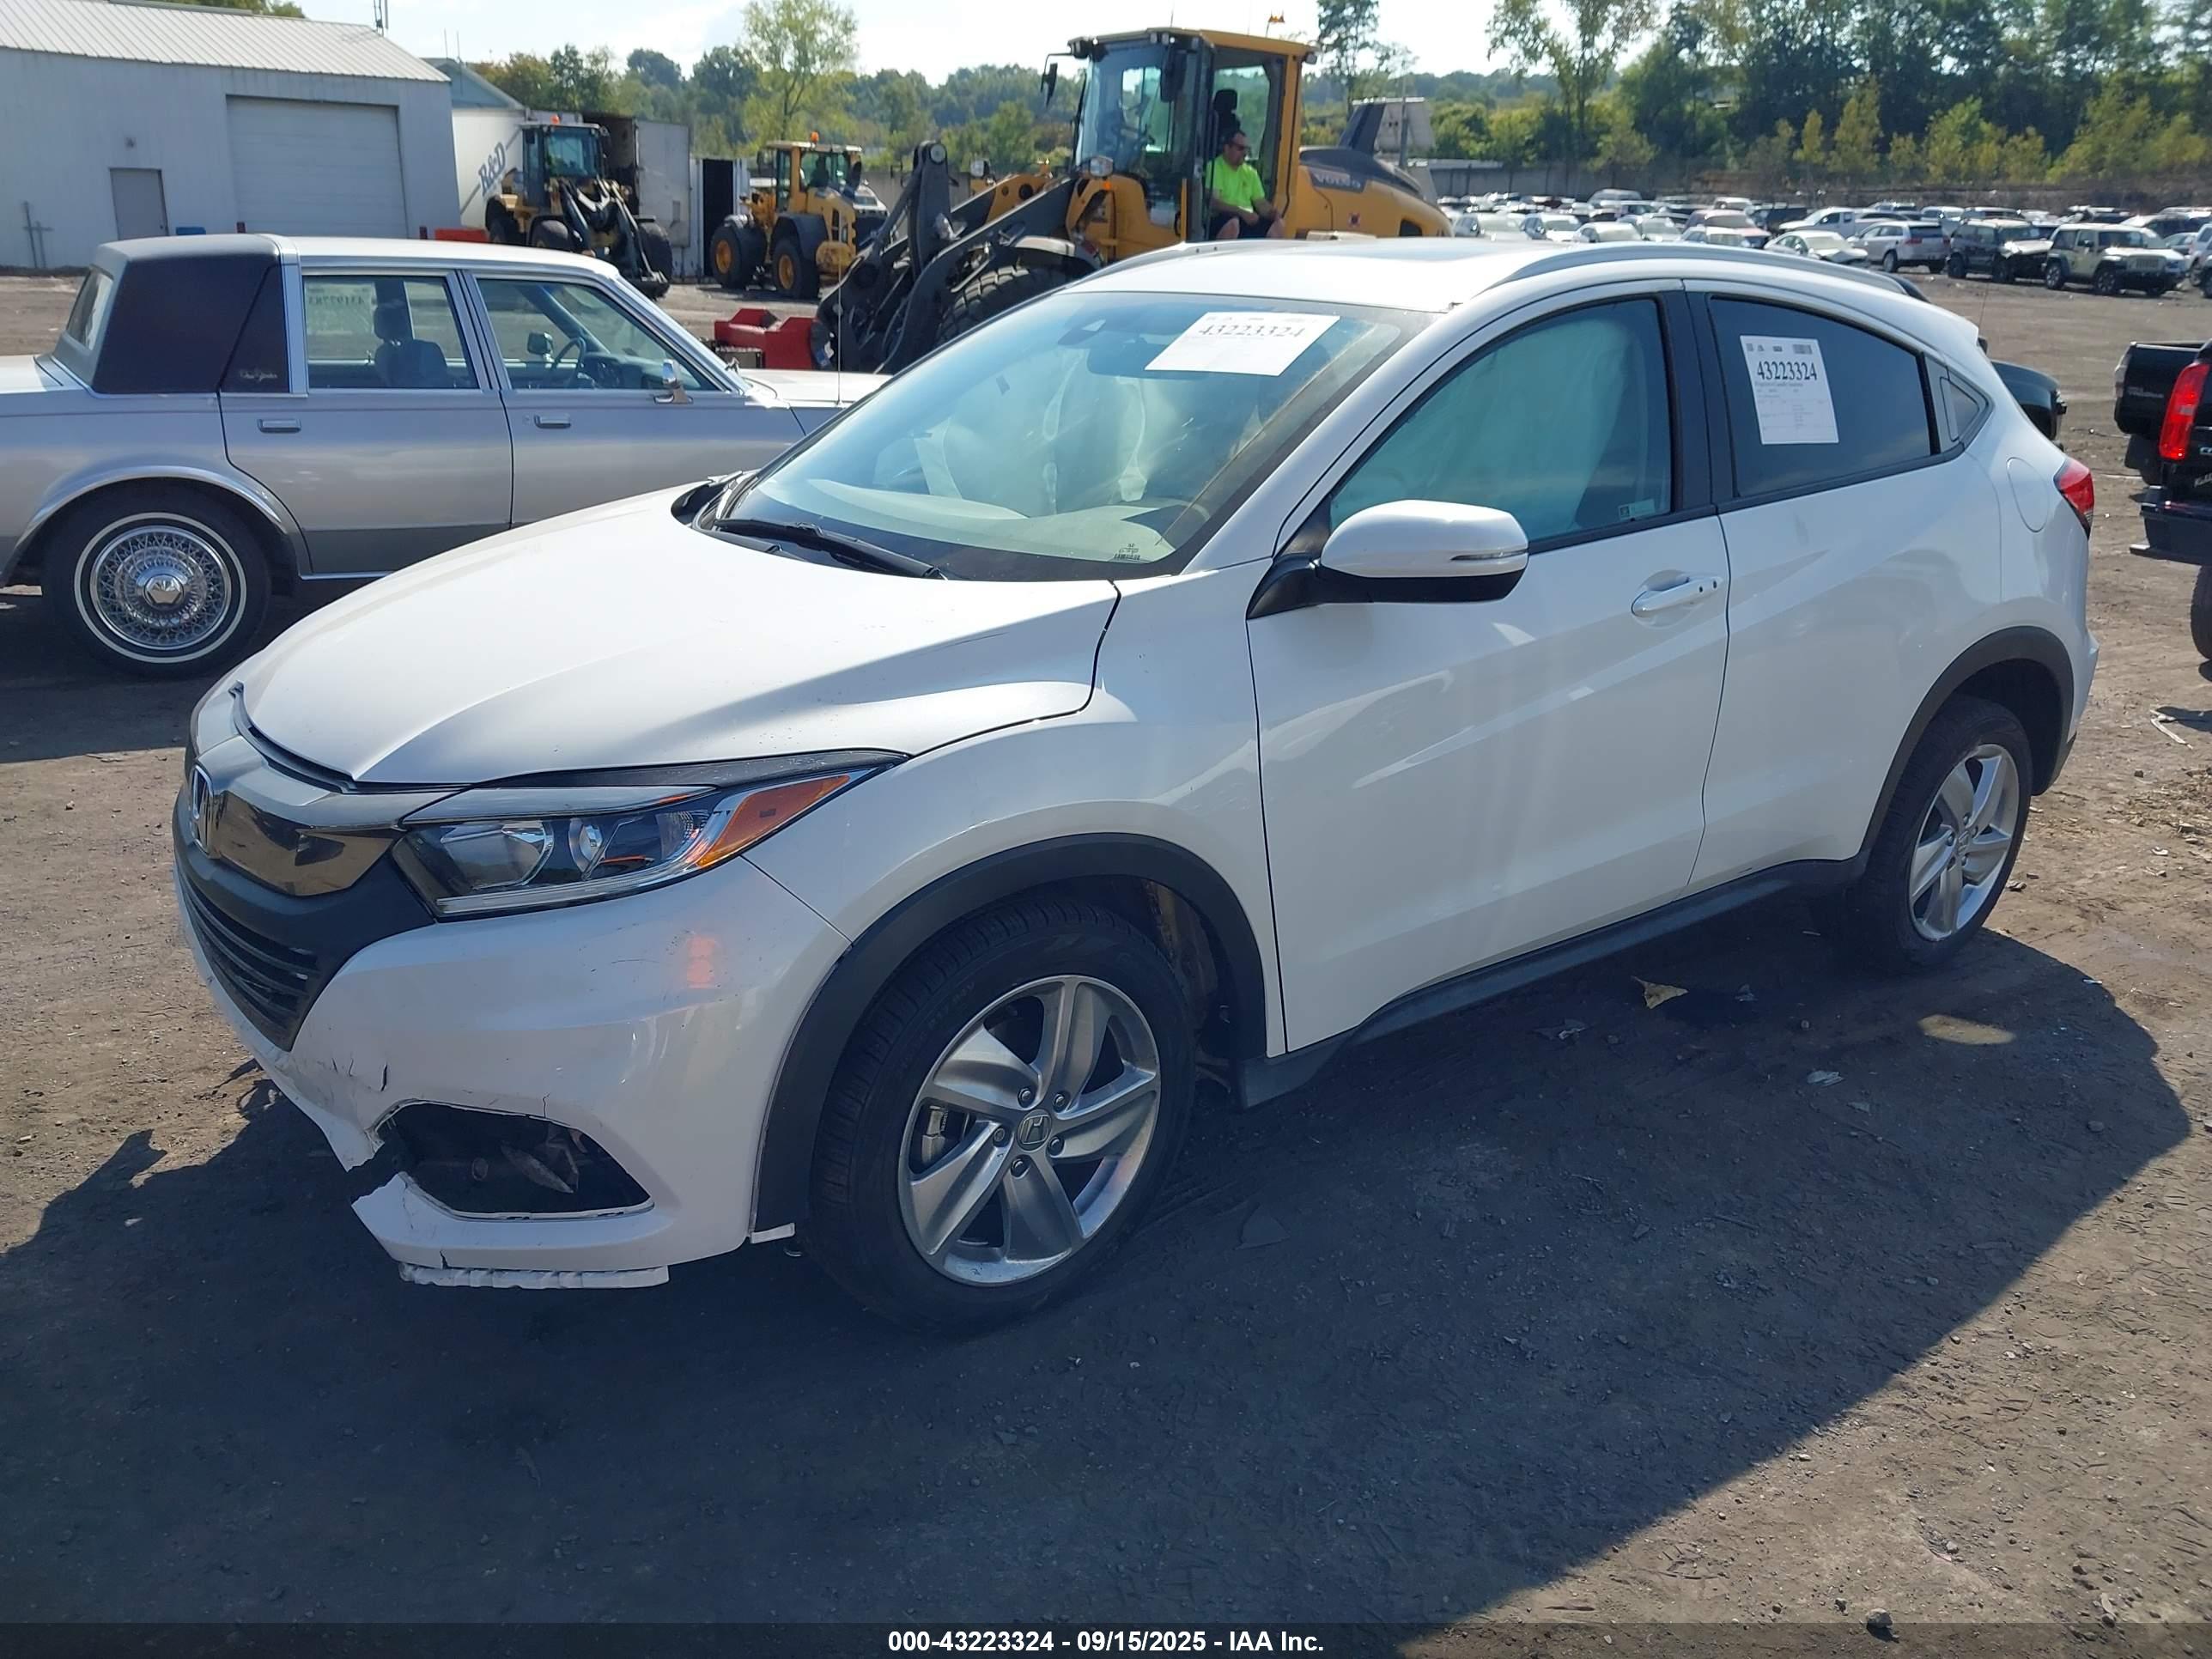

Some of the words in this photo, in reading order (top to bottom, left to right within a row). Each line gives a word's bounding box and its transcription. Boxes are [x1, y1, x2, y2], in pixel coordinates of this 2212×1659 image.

[478, 142, 506, 197] R&D
[1315, 173, 1361, 189] VOLVO
[1199, 325, 1306, 337] 43223324
[1757, 361, 1818, 380] 43223324
